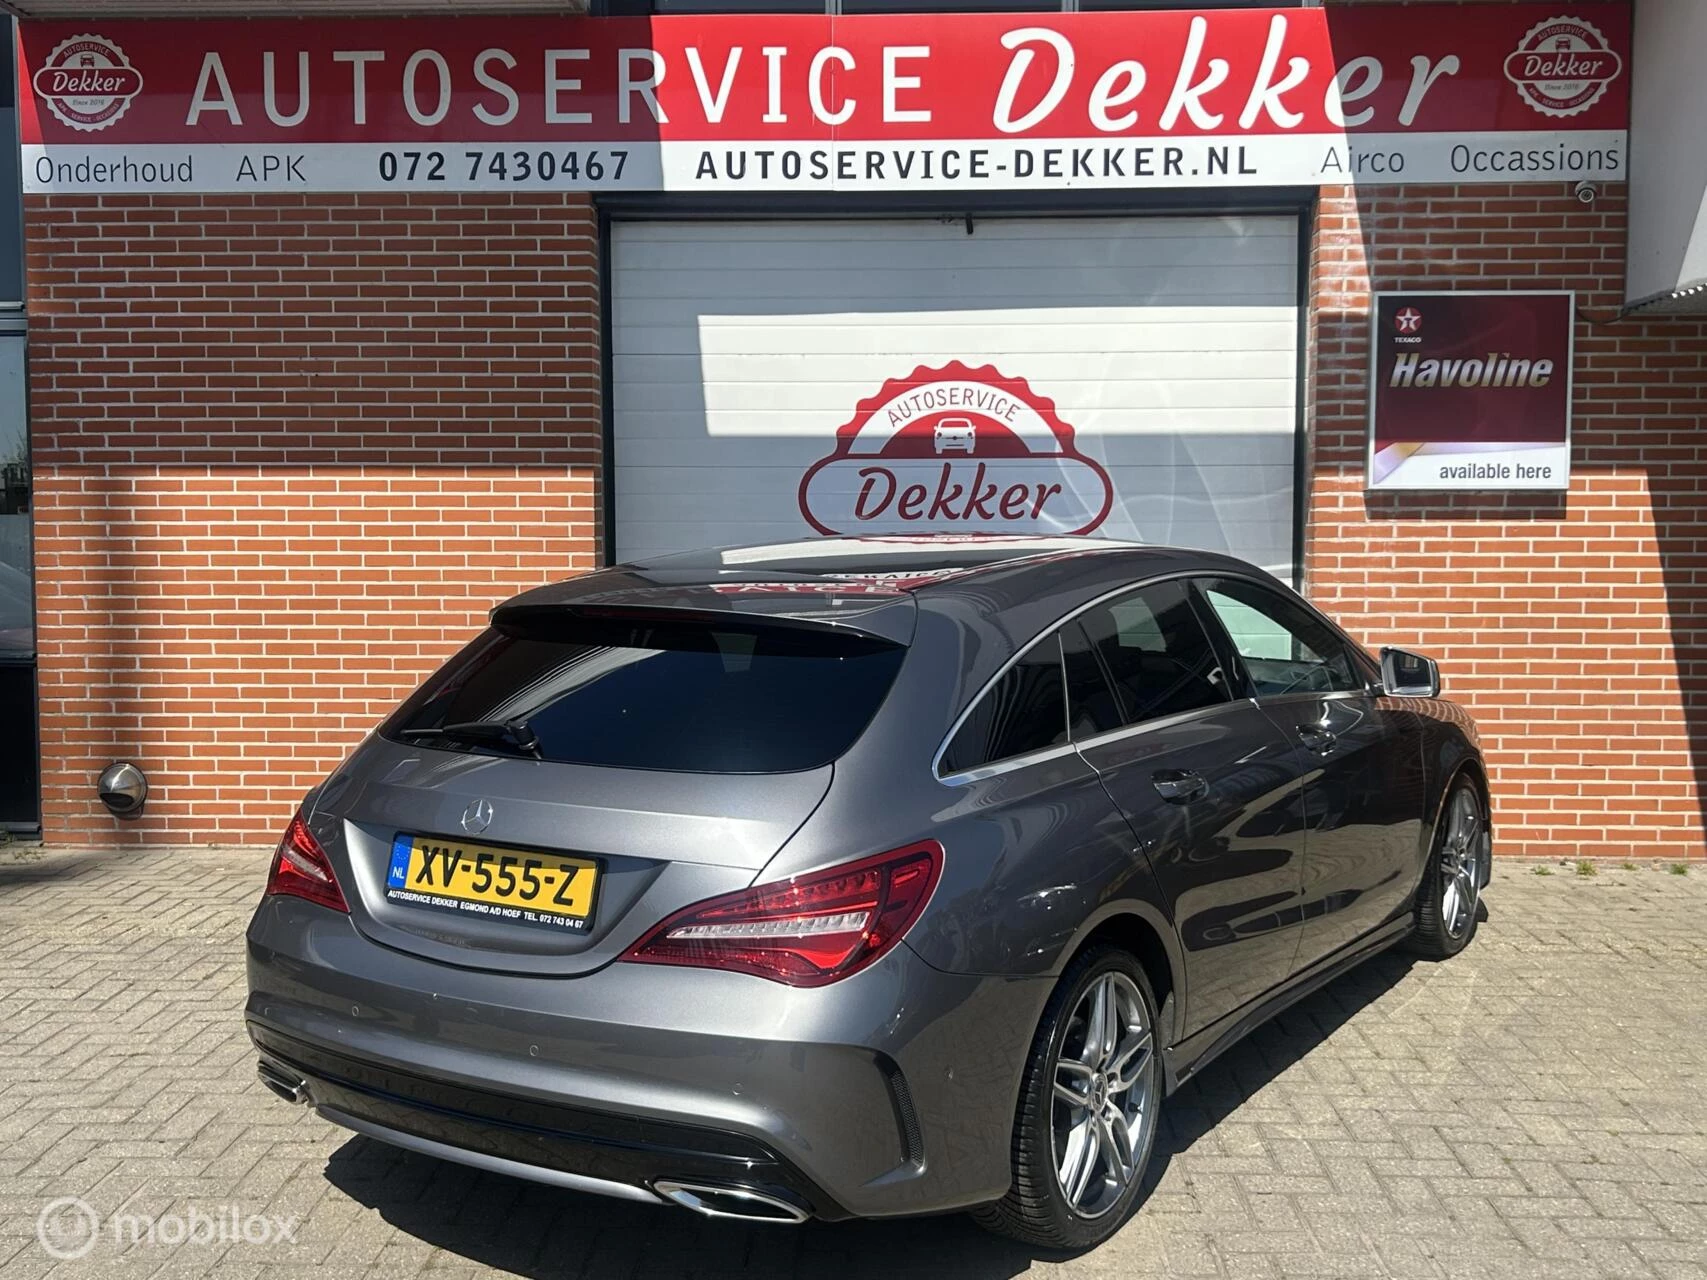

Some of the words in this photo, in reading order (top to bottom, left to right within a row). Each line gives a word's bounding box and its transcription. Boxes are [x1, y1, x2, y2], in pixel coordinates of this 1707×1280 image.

[1537, 25, 1588, 41] AUTOSERVICE
[63, 43, 111, 58] AUTOSERVICE
[1524, 53, 1603, 76] Dekker
[53, 70, 125, 92] Dekker
[185, 46, 932, 127] AUTOSERVICE
[993, 14, 1460, 133] Dekker
[36, 156, 193, 183] Onderhoud
[236, 155, 306, 182] APK
[379, 151, 446, 181] 072
[465, 151, 629, 181] 7430467
[696, 146, 1257, 180] AUTOSERVICE-DEKKER.NL
[1320, 146, 1404, 174] Airco
[1451, 144, 1619, 173] Occassions
[1389, 353, 1554, 387] Havoline
[886, 387, 1021, 428] AUTOSERVICE
[1440, 463, 1510, 479] available
[1516, 463, 1551, 479] here
[854, 462, 1062, 520] Dekker
[392, 867, 404, 879] NL
[416, 845, 579, 906] XV-555-Z
[388, 890, 431, 904] AUTOSERVICE
[431, 897, 458, 909] DEKKER
[460, 901, 489, 914] EGMOND
[502, 908, 521, 918] HOEF
[540, 914, 552, 924] 072
[553, 916, 564, 926] 743
